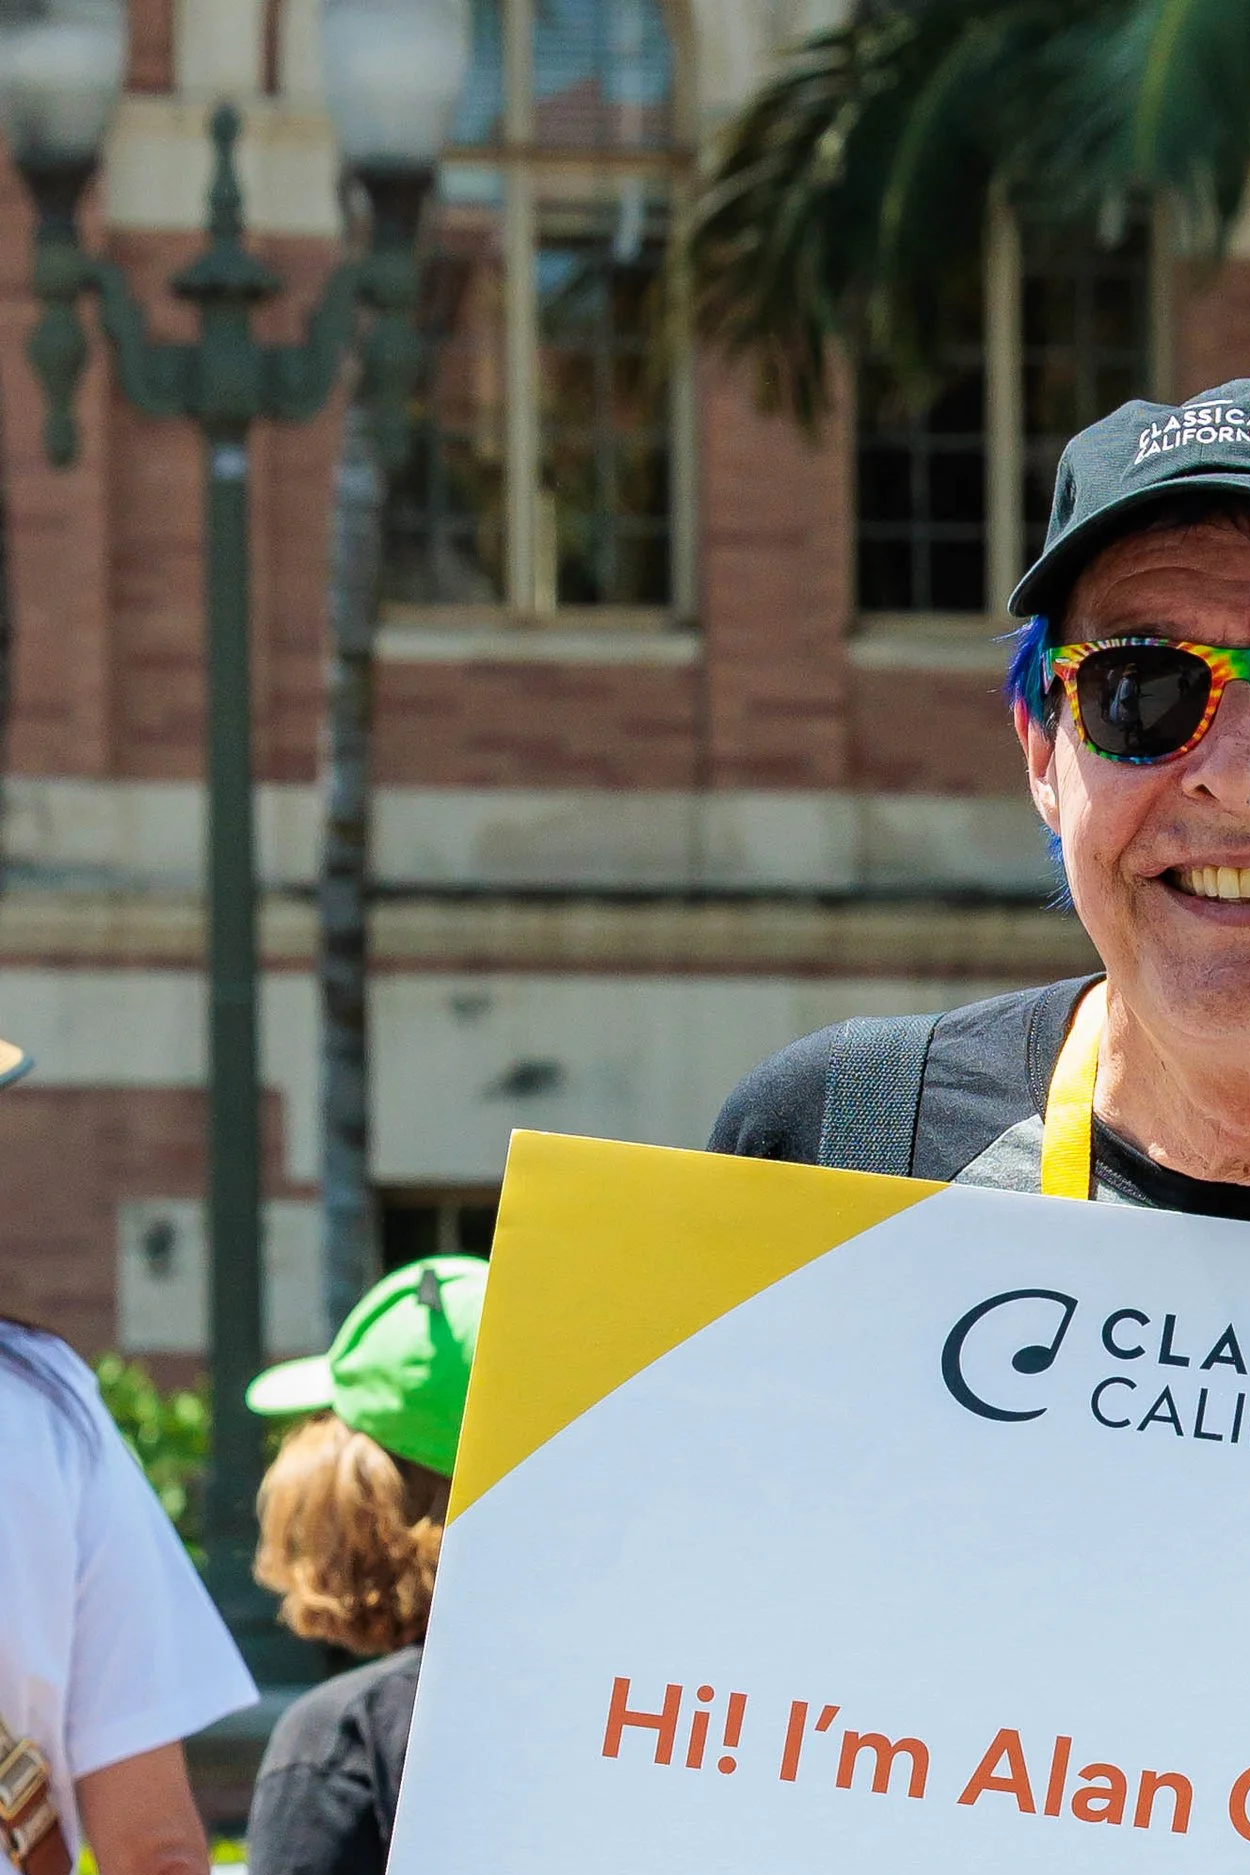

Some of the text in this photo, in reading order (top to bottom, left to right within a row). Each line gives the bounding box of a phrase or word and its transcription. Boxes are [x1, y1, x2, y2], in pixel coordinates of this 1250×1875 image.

[602, 1677, 747, 1775] Hi!
[779, 1700, 930, 1799] I'm
[958, 1728, 1193, 1834] Alan
